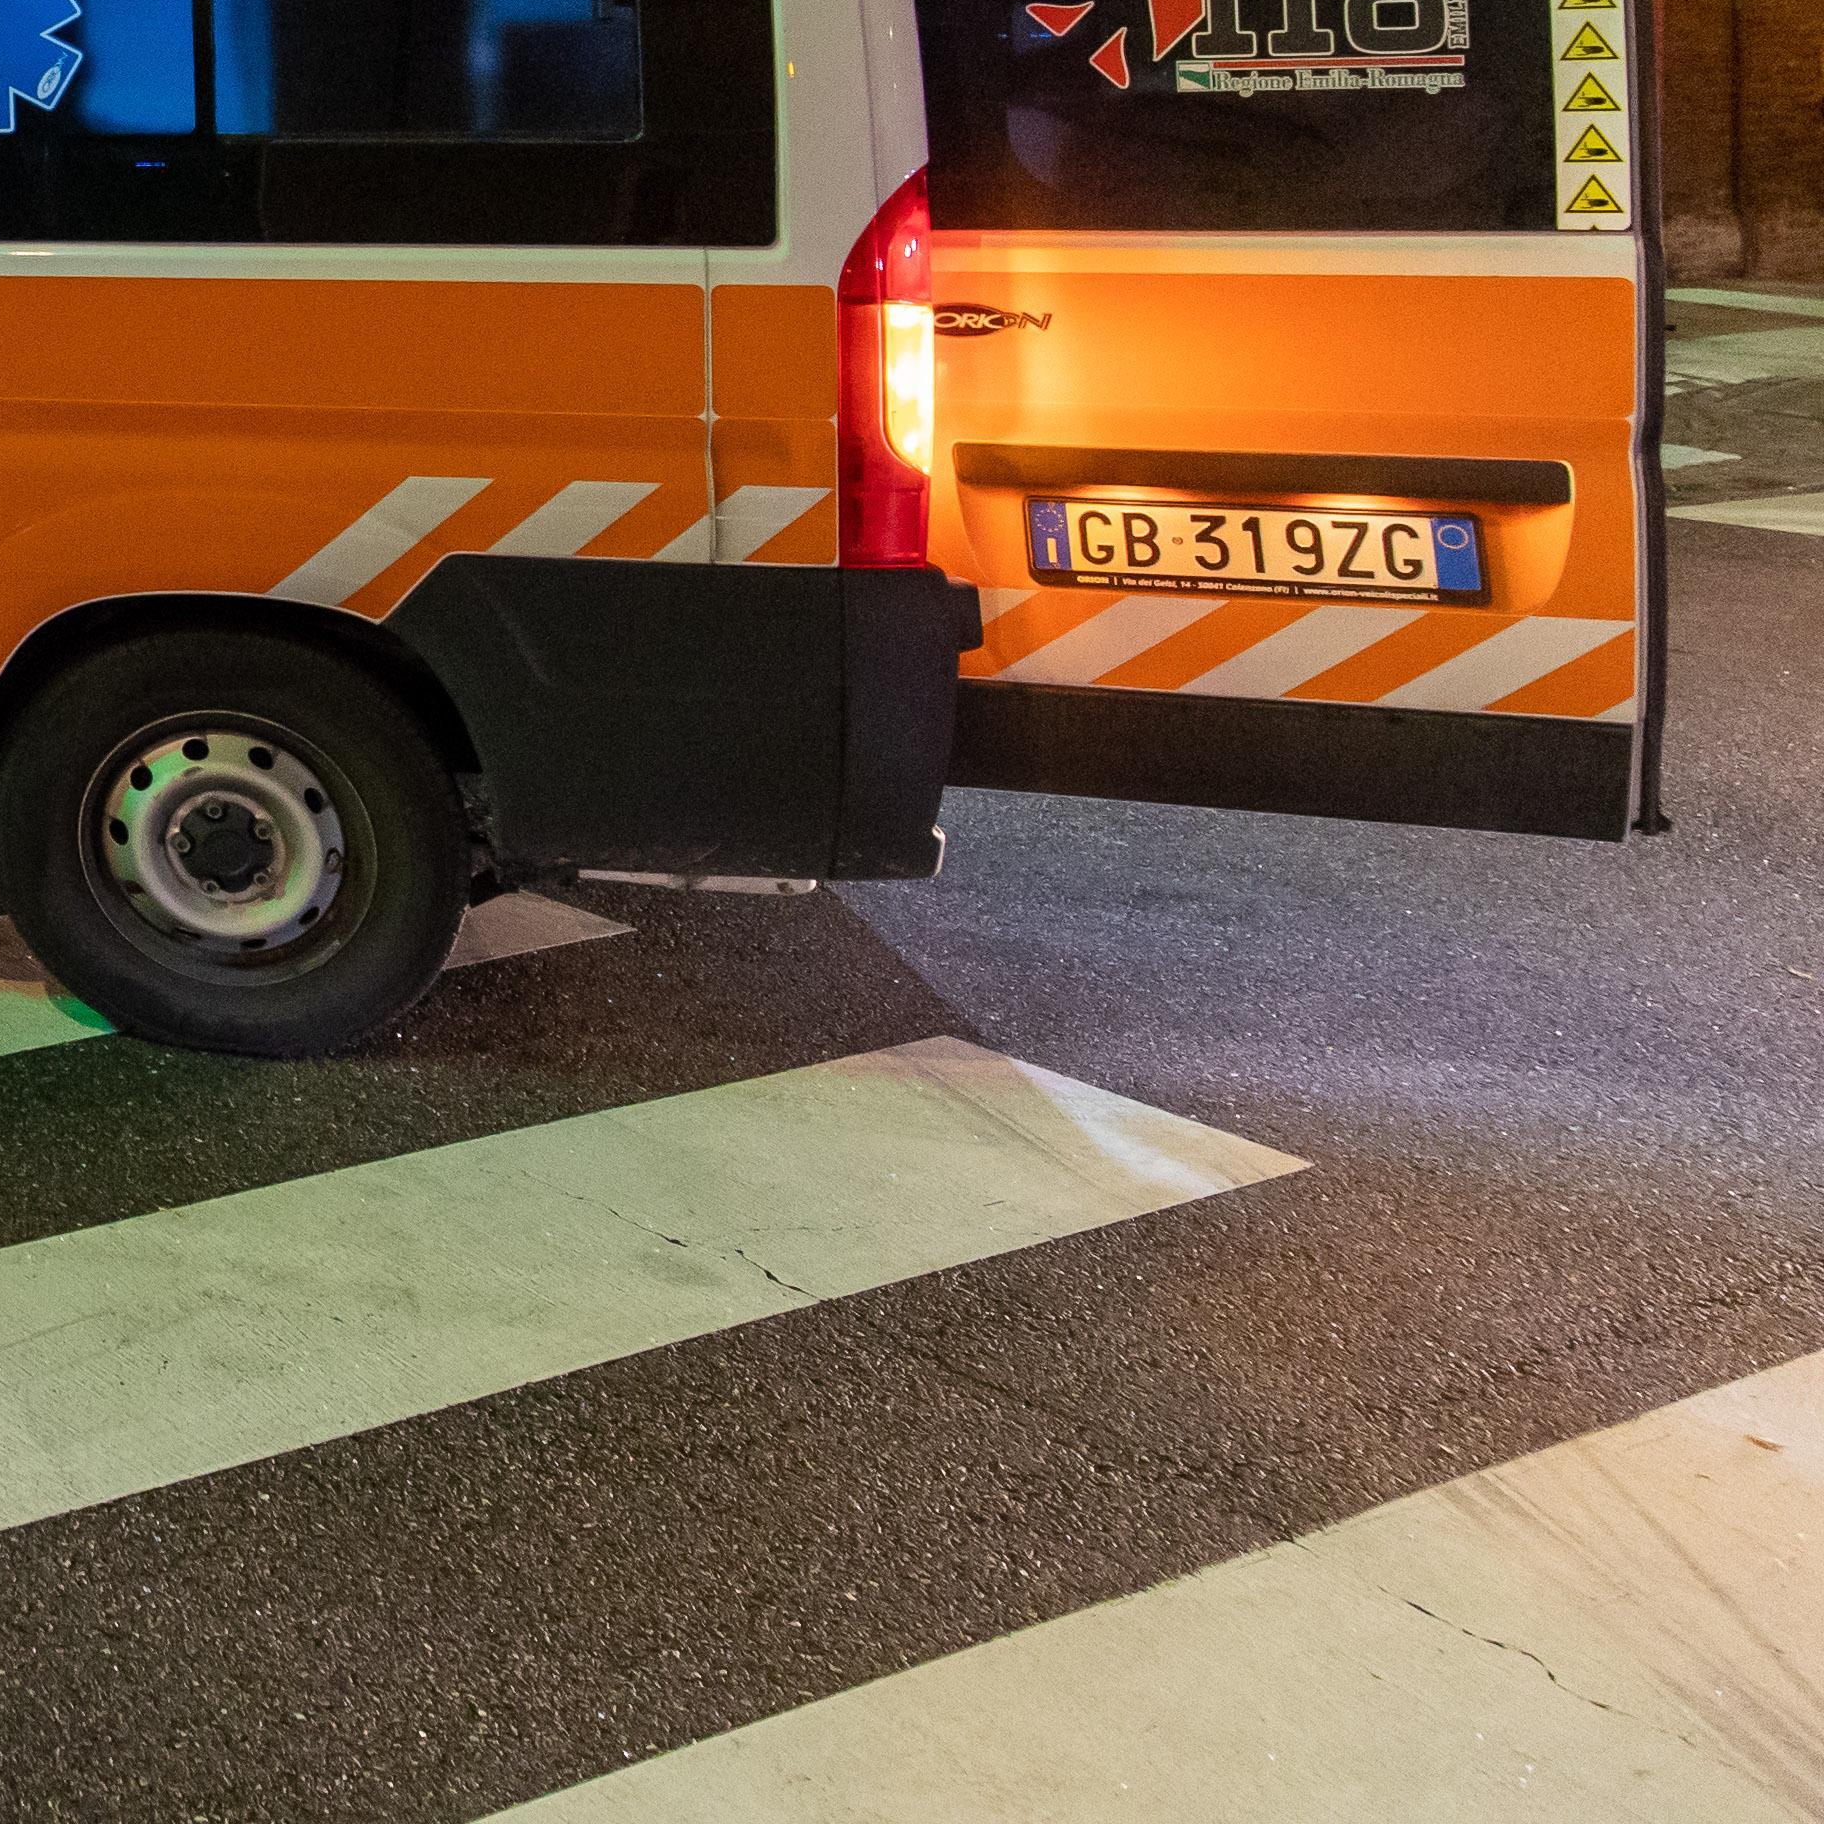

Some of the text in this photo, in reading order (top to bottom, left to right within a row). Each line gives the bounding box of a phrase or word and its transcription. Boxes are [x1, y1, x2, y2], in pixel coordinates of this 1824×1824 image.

[1212, 68, 1465, 97] Regione Emilia-Romagna
[933, 311, 1053, 332] ORION
[1078, 510, 1160, 570] GB
[1190, 513, 1424, 582] 319ZG
[1122, 578, 1137, 586] Via
